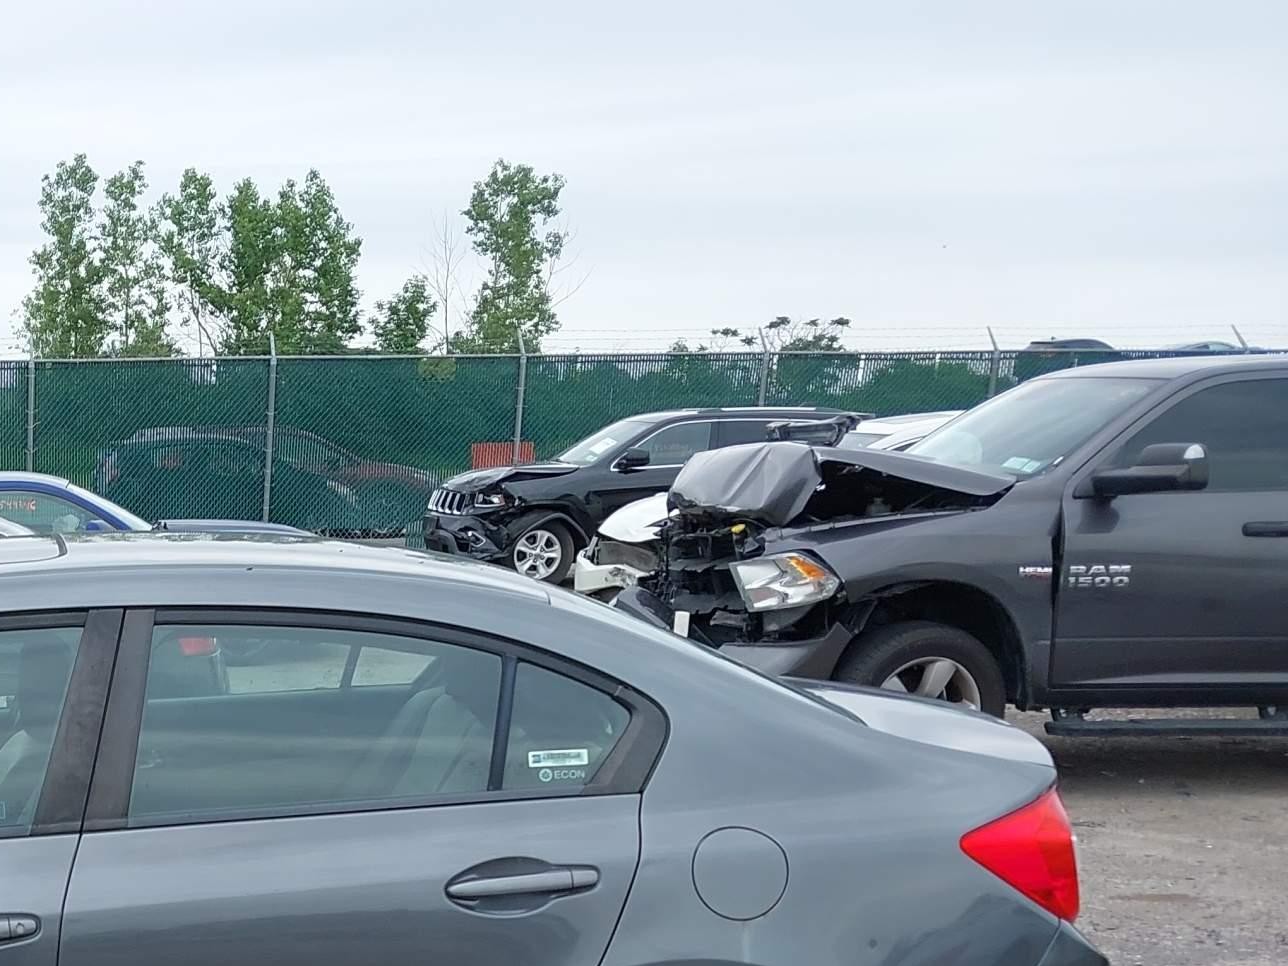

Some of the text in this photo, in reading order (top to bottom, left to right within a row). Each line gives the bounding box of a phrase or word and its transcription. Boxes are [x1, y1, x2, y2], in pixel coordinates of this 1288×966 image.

[1069, 564, 1132, 576] RAM
[1067, 576, 1130, 588] 1500
[554, 769, 586, 780] ECON
